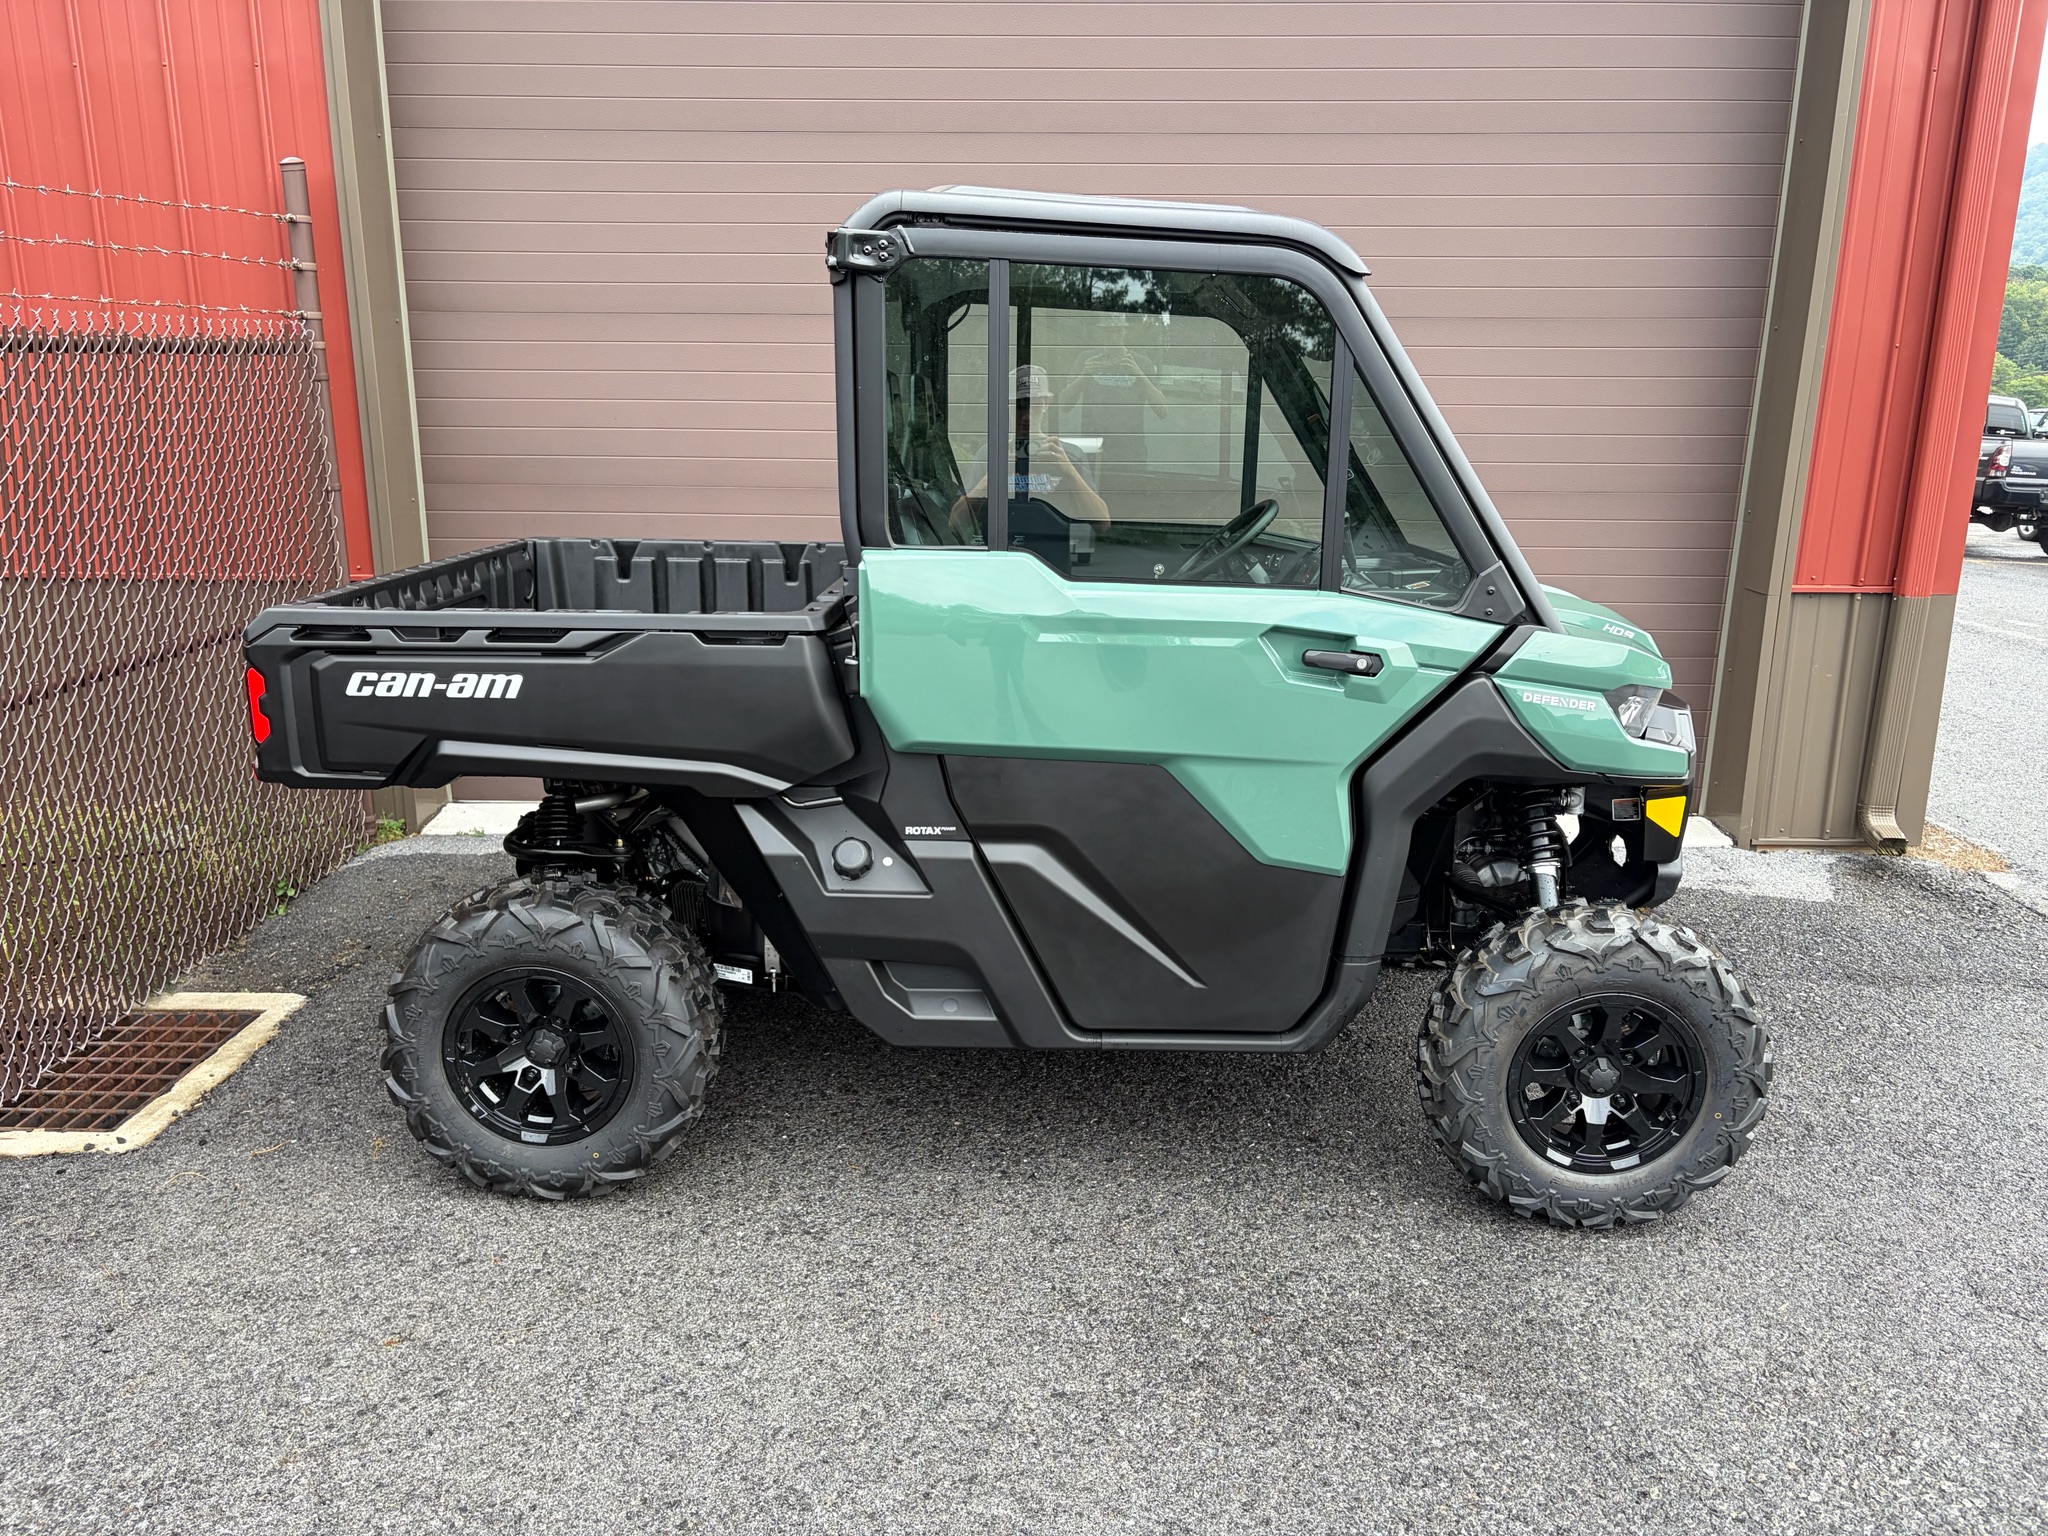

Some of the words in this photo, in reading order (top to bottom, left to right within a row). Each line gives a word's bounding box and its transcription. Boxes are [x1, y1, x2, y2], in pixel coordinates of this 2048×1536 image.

[345, 671, 524, 699] can-am
[1522, 692, 1597, 712] DEFENDER
[905, 826, 941, 835] ROTAX
